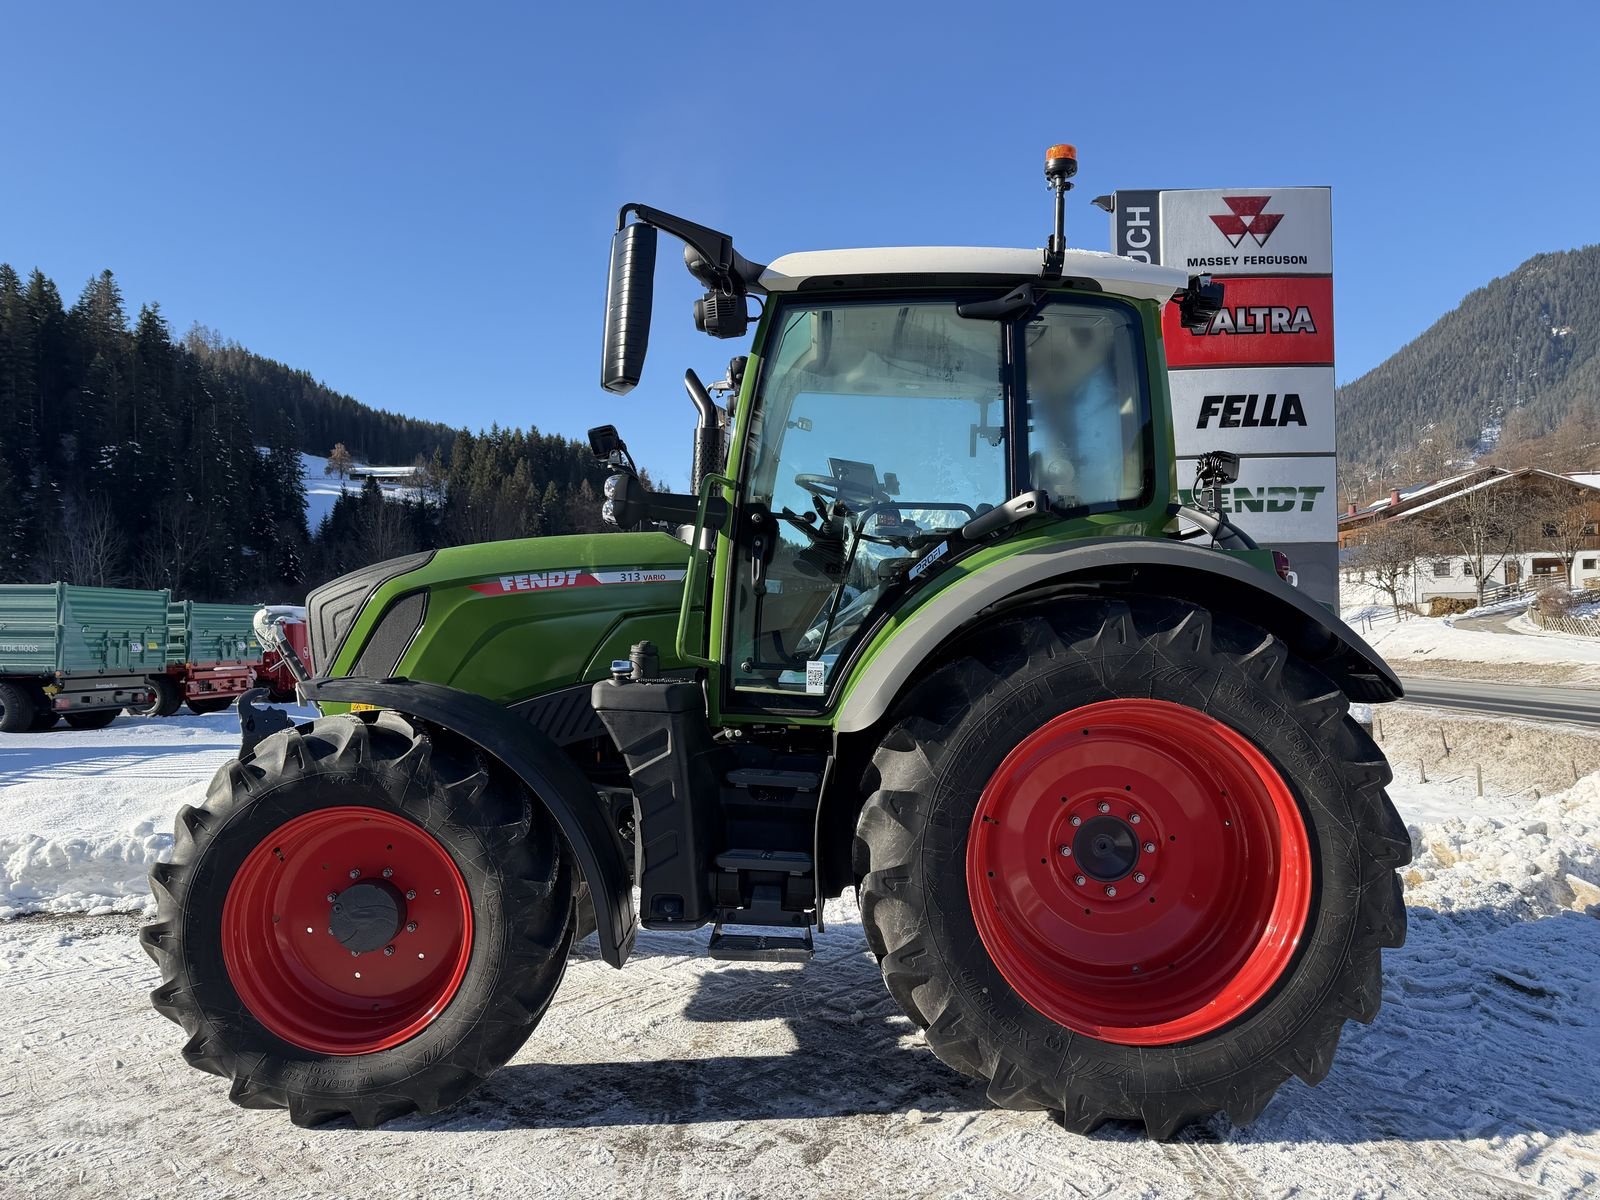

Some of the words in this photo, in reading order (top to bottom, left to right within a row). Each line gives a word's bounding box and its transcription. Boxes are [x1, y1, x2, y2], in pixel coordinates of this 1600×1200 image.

[1187, 256, 1239, 268] MASSEY
[1243, 255, 1308, 266] FERGUSON
[1196, 393, 1308, 430] FELLA
[915, 547, 942, 574] PROFI
[500, 569, 582, 592] FENDT
[620, 572, 641, 582] 313
[643, 573, 666, 581] VARIO
